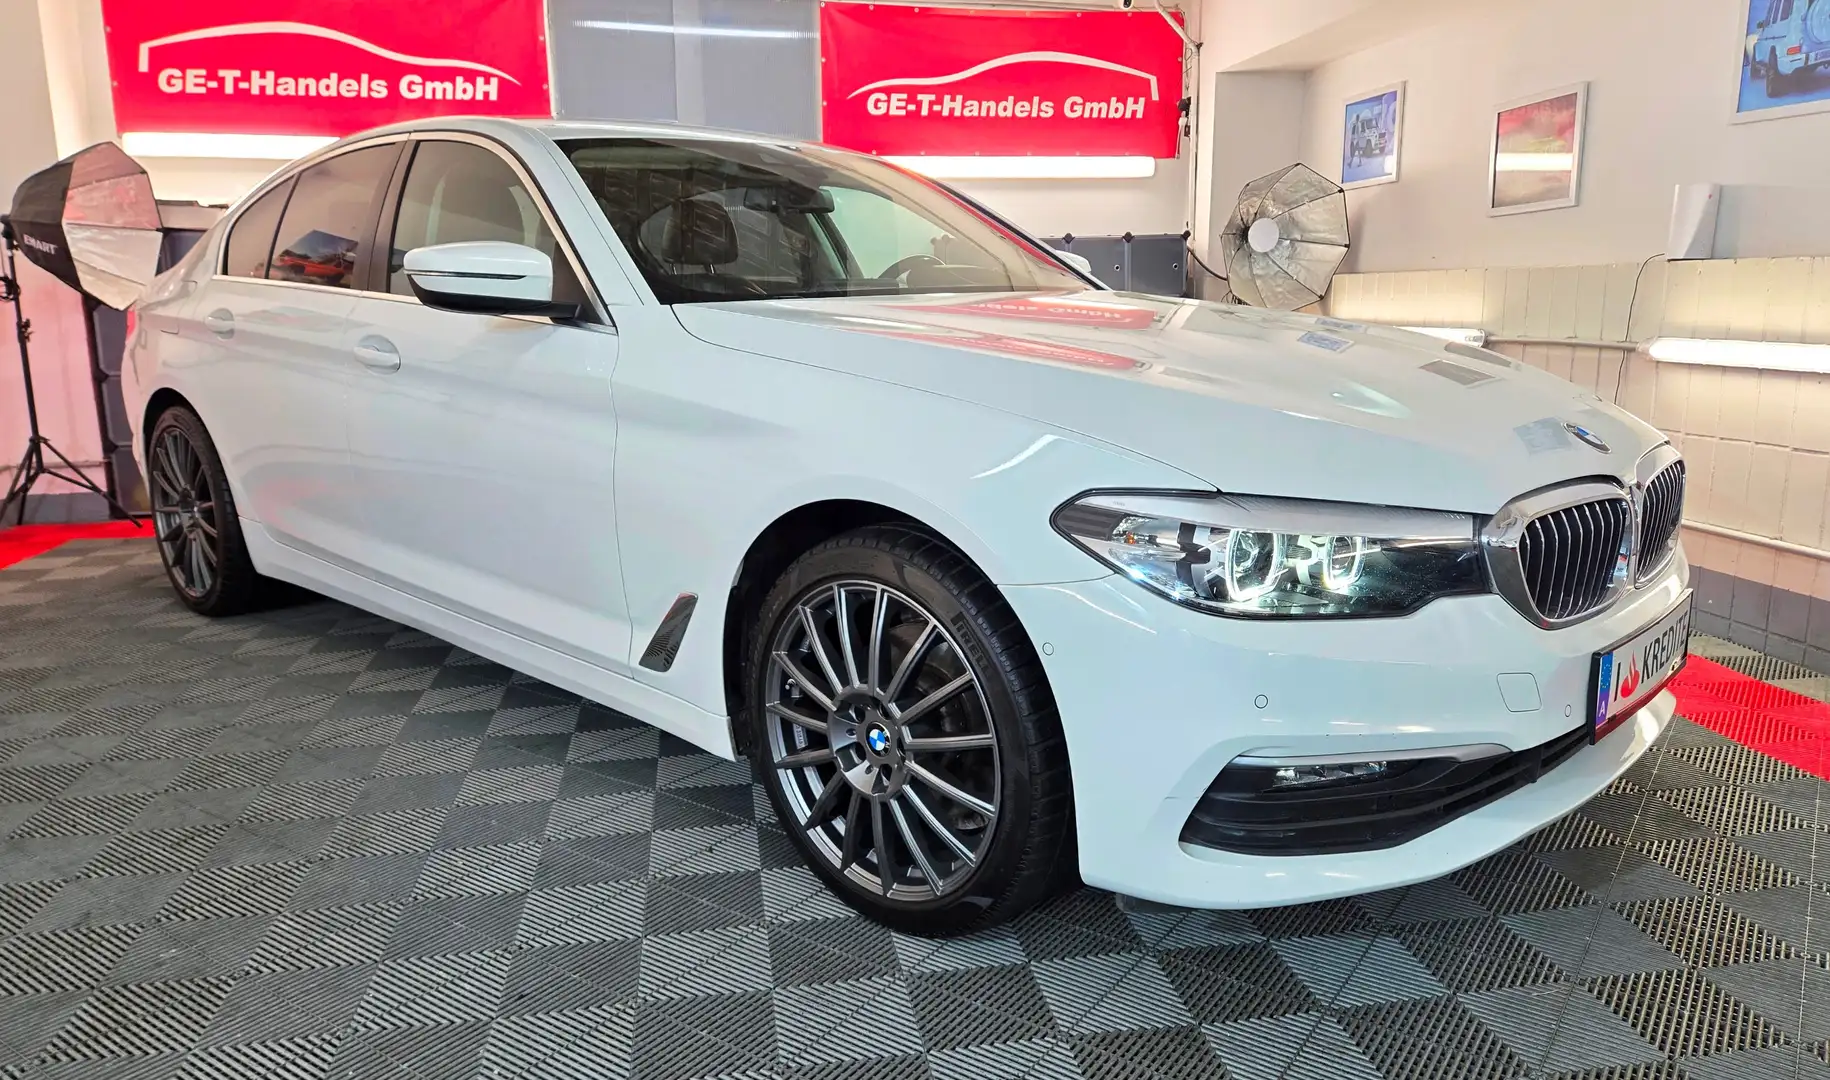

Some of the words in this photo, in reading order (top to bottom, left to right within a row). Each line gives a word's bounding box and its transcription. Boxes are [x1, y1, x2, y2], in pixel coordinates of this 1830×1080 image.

[157, 68, 389, 99] GE-T-Handels
[399, 74, 499, 101] GmbH
[866, 92, 1054, 118] GE-T-Handels
[1064, 95, 1146, 119] GmbH
[23, 233, 58, 255] EMART
[1614, 662, 1621, 702] I
[1641, 610, 1688, 683] KREDITE
[1598, 700, 1606, 718] A
